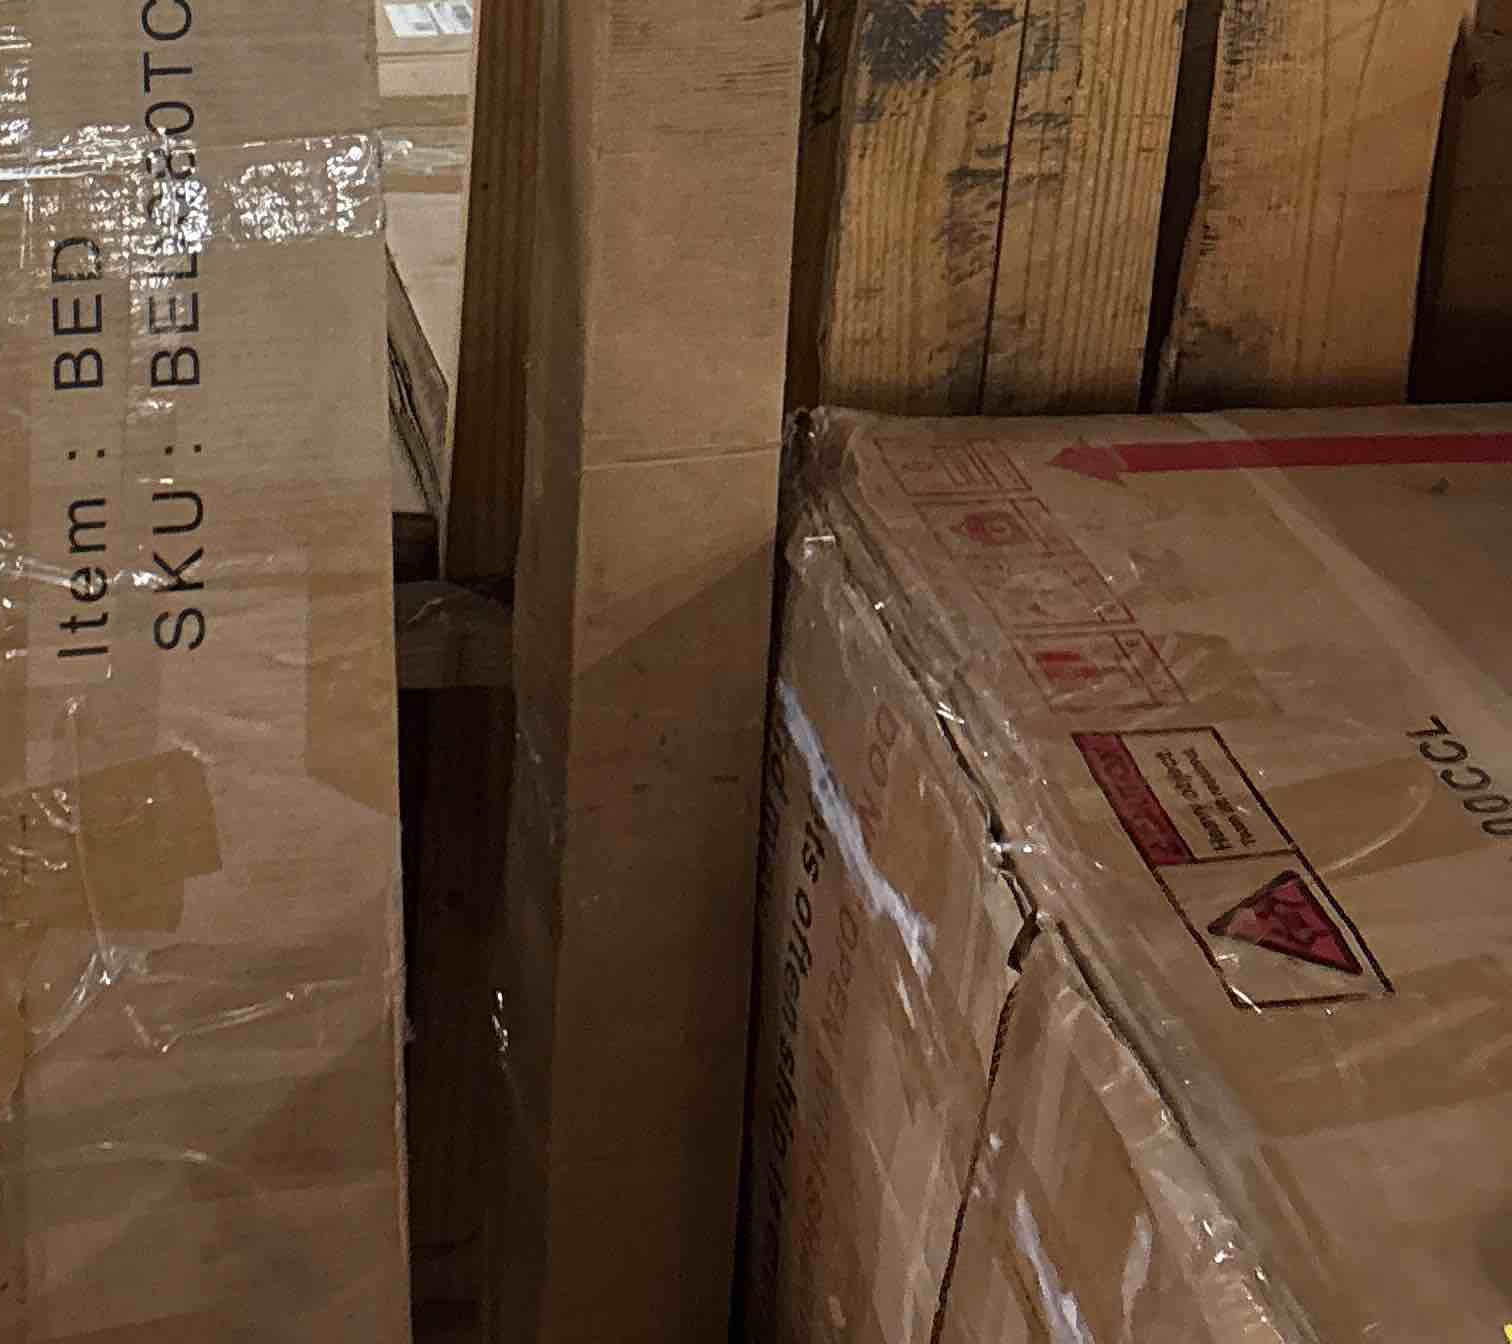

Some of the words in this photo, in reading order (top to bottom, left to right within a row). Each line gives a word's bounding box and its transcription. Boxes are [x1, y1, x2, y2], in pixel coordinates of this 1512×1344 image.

[50, 236, 105, 391] BED
[56, 497, 110, 658] Item
[151, 490, 207, 652] SKU
[783, 887, 814, 1035] often
[769, 1036, 798, 1158] ship
